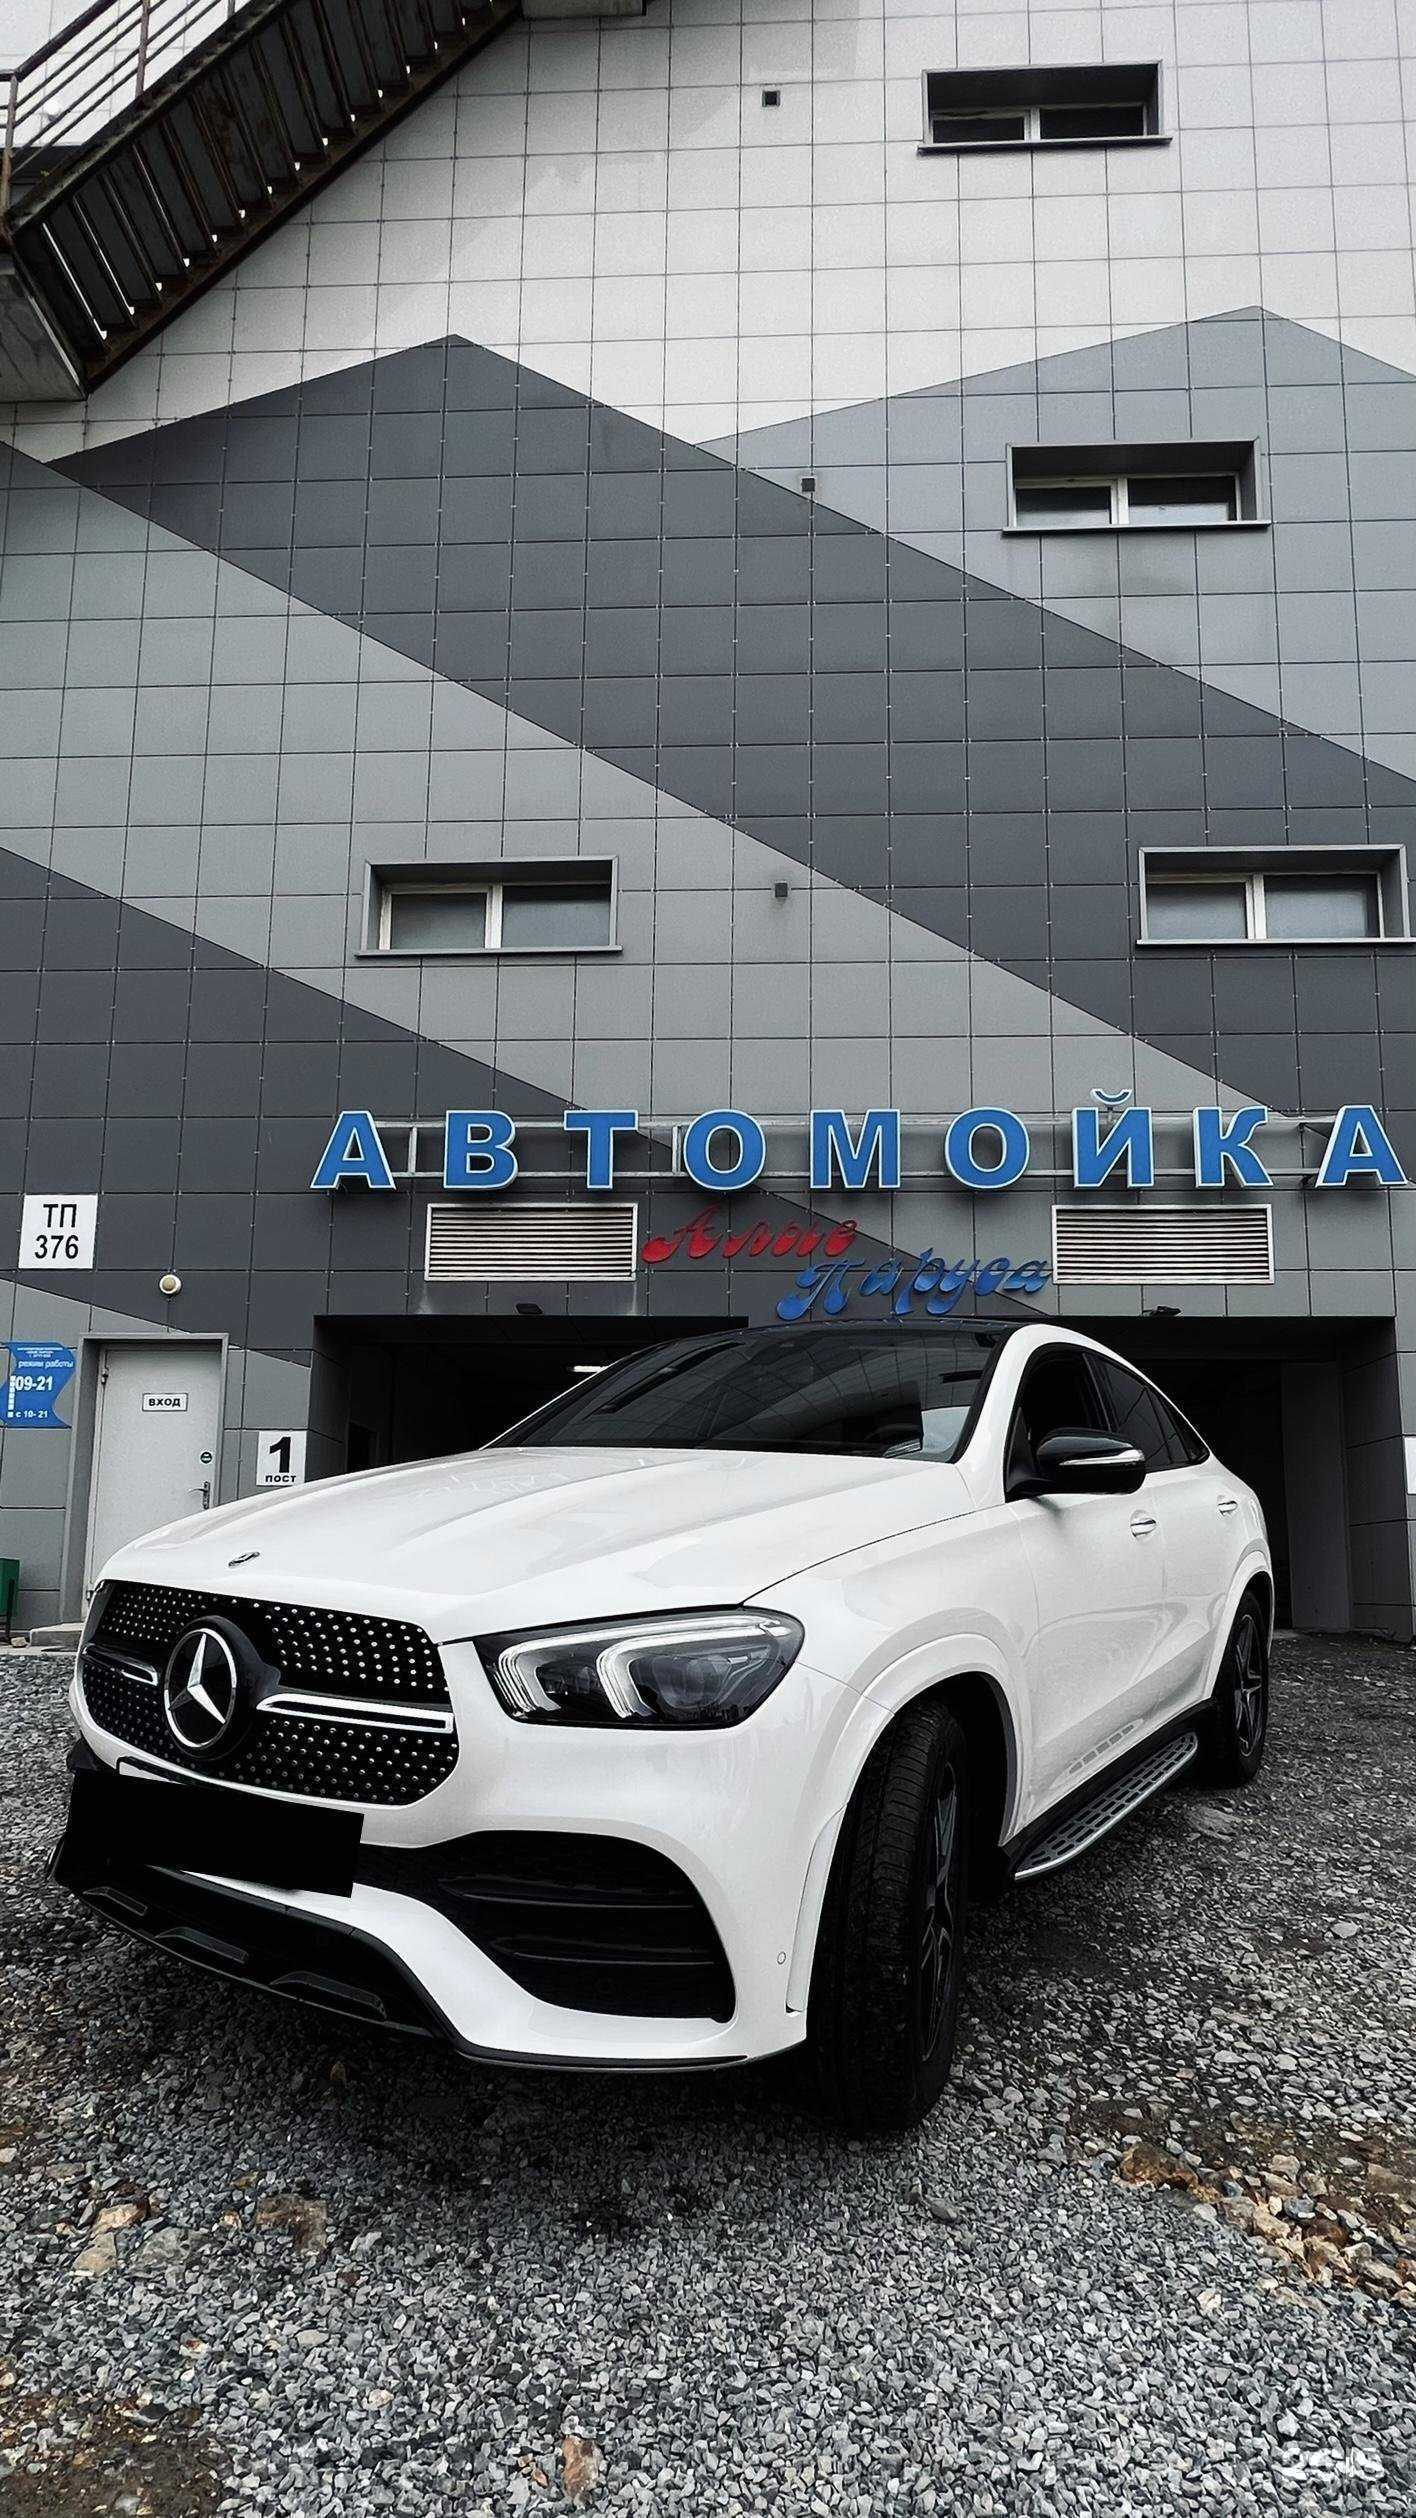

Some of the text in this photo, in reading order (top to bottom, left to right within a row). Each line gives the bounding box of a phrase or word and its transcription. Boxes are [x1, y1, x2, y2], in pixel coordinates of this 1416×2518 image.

[310, 1089, 1408, 1190] АВТОМОЙКА
[43, 1203, 77, 1228] ТП
[34, 1234, 79, 1260] 376
[269, 1436, 292, 1474] 1
